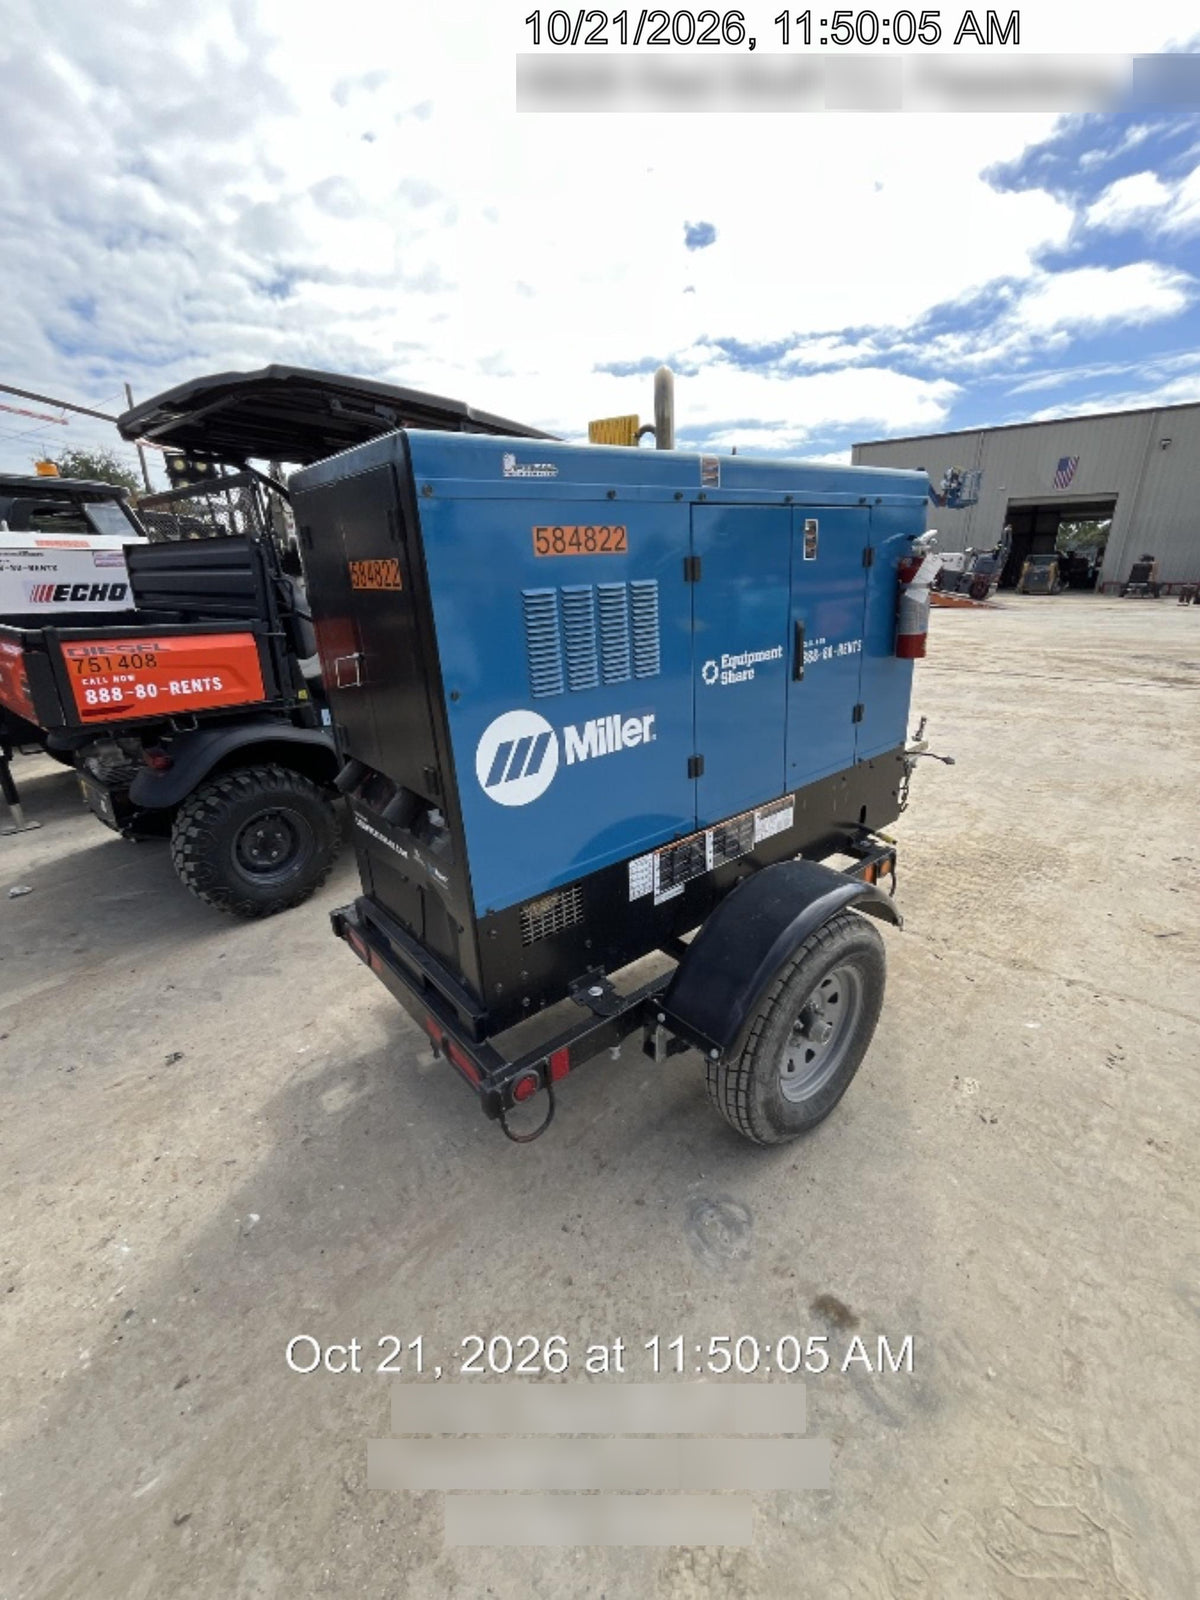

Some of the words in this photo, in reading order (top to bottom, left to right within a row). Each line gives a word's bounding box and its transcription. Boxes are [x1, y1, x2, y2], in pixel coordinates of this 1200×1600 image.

[535, 526, 626, 554] 584822
[351, 559, 401, 588] 584822
[53, 583, 128, 602] ECHO
[72, 653, 158, 674] 751408
[721, 644, 783, 669] Equipment
[113, 674, 135, 683] NOW
[721, 668, 755, 685] Share
[85, 676, 223, 705] 888-80-RENTS
[563, 713, 656, 766] Miller
